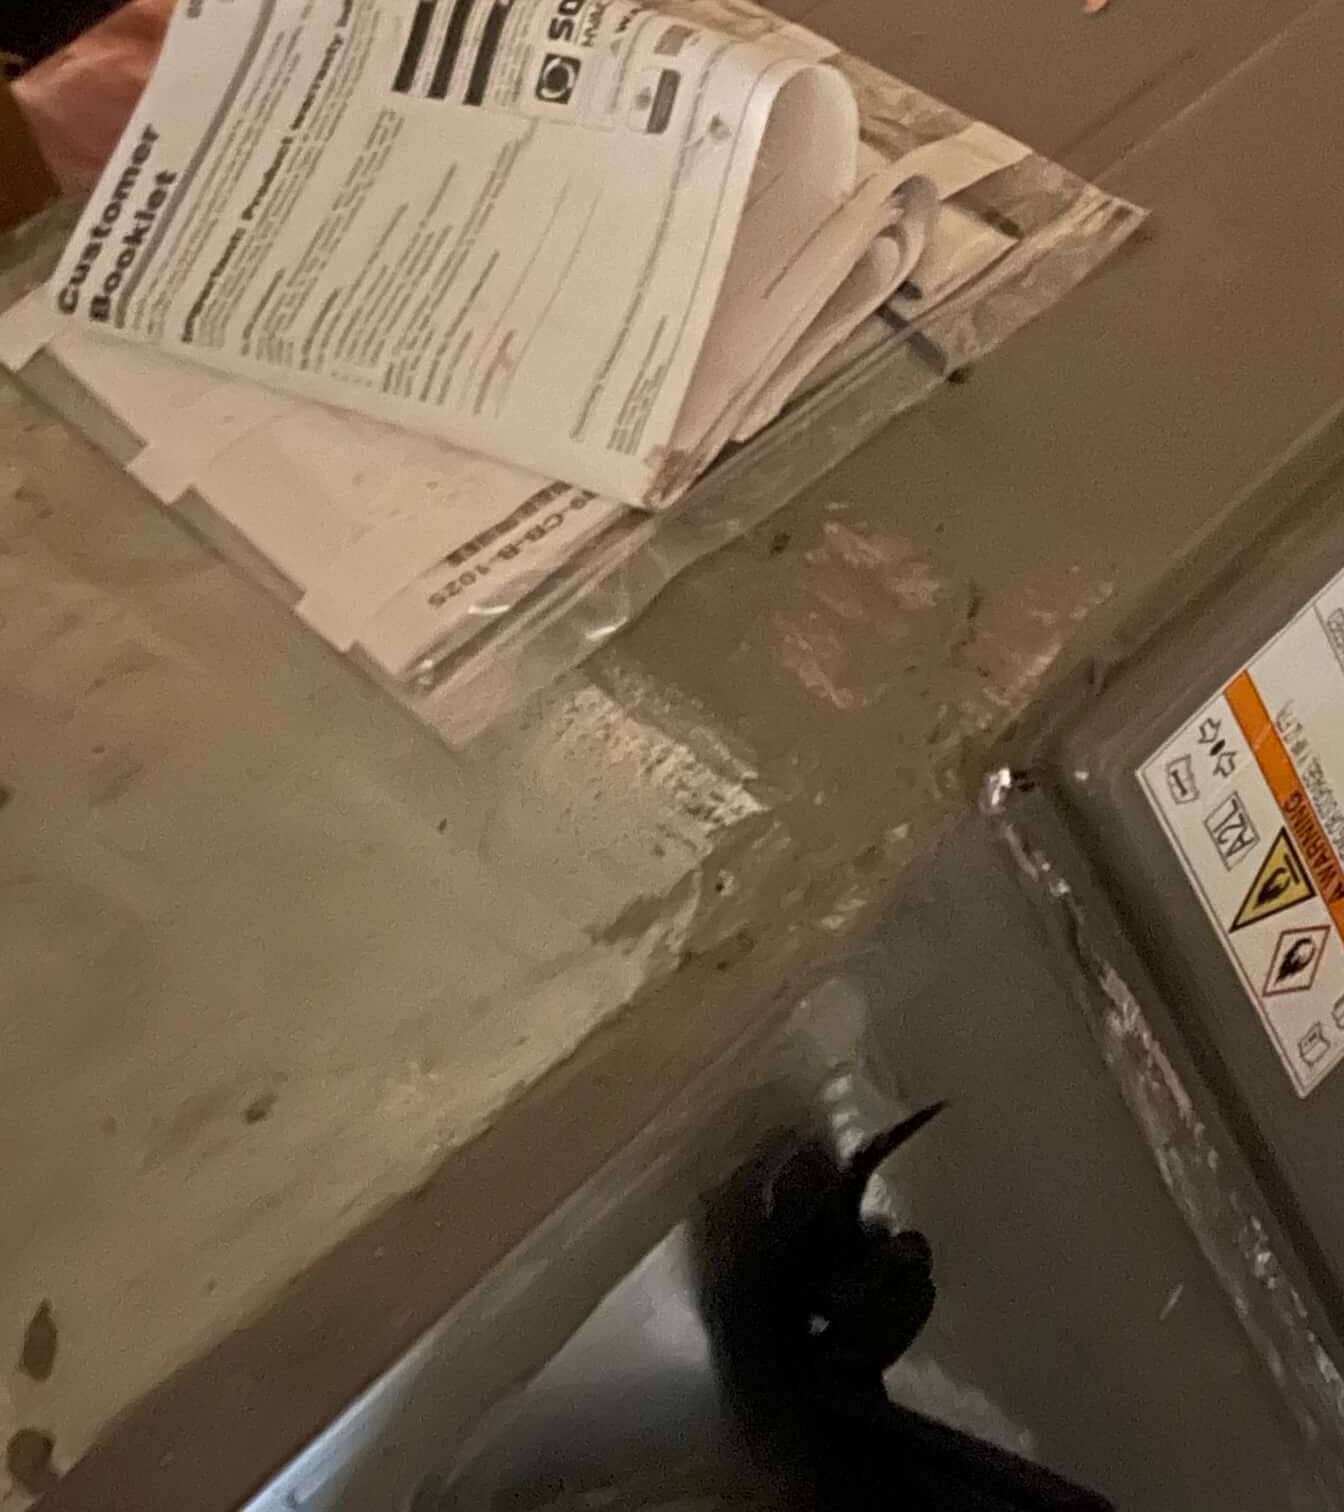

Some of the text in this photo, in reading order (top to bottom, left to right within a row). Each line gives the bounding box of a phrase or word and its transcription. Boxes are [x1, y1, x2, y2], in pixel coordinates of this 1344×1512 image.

[57, 122, 163, 317] Customer
[89, 168, 180, 326] Booklet
[1210, 794, 1256, 863] A2L
[1282, 790, 1338, 890] WARNING
